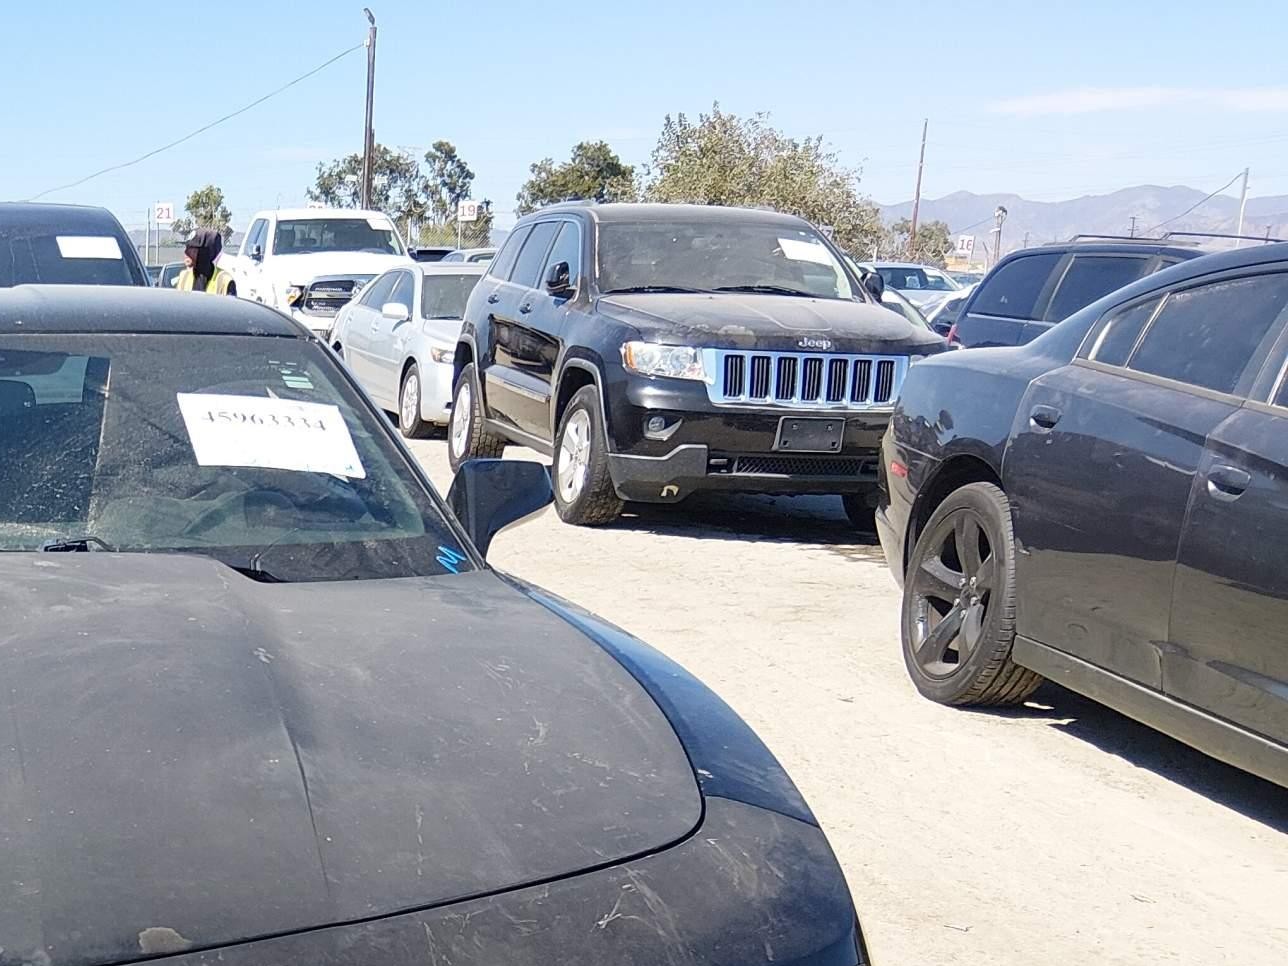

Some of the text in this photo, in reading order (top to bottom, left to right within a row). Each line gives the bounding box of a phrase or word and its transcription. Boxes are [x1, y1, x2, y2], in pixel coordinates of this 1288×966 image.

[156, 207, 171, 219] 21
[459, 205, 476, 217] 19
[798, 337, 831, 350] Jeep
[201, 411, 327, 431] 45963334
